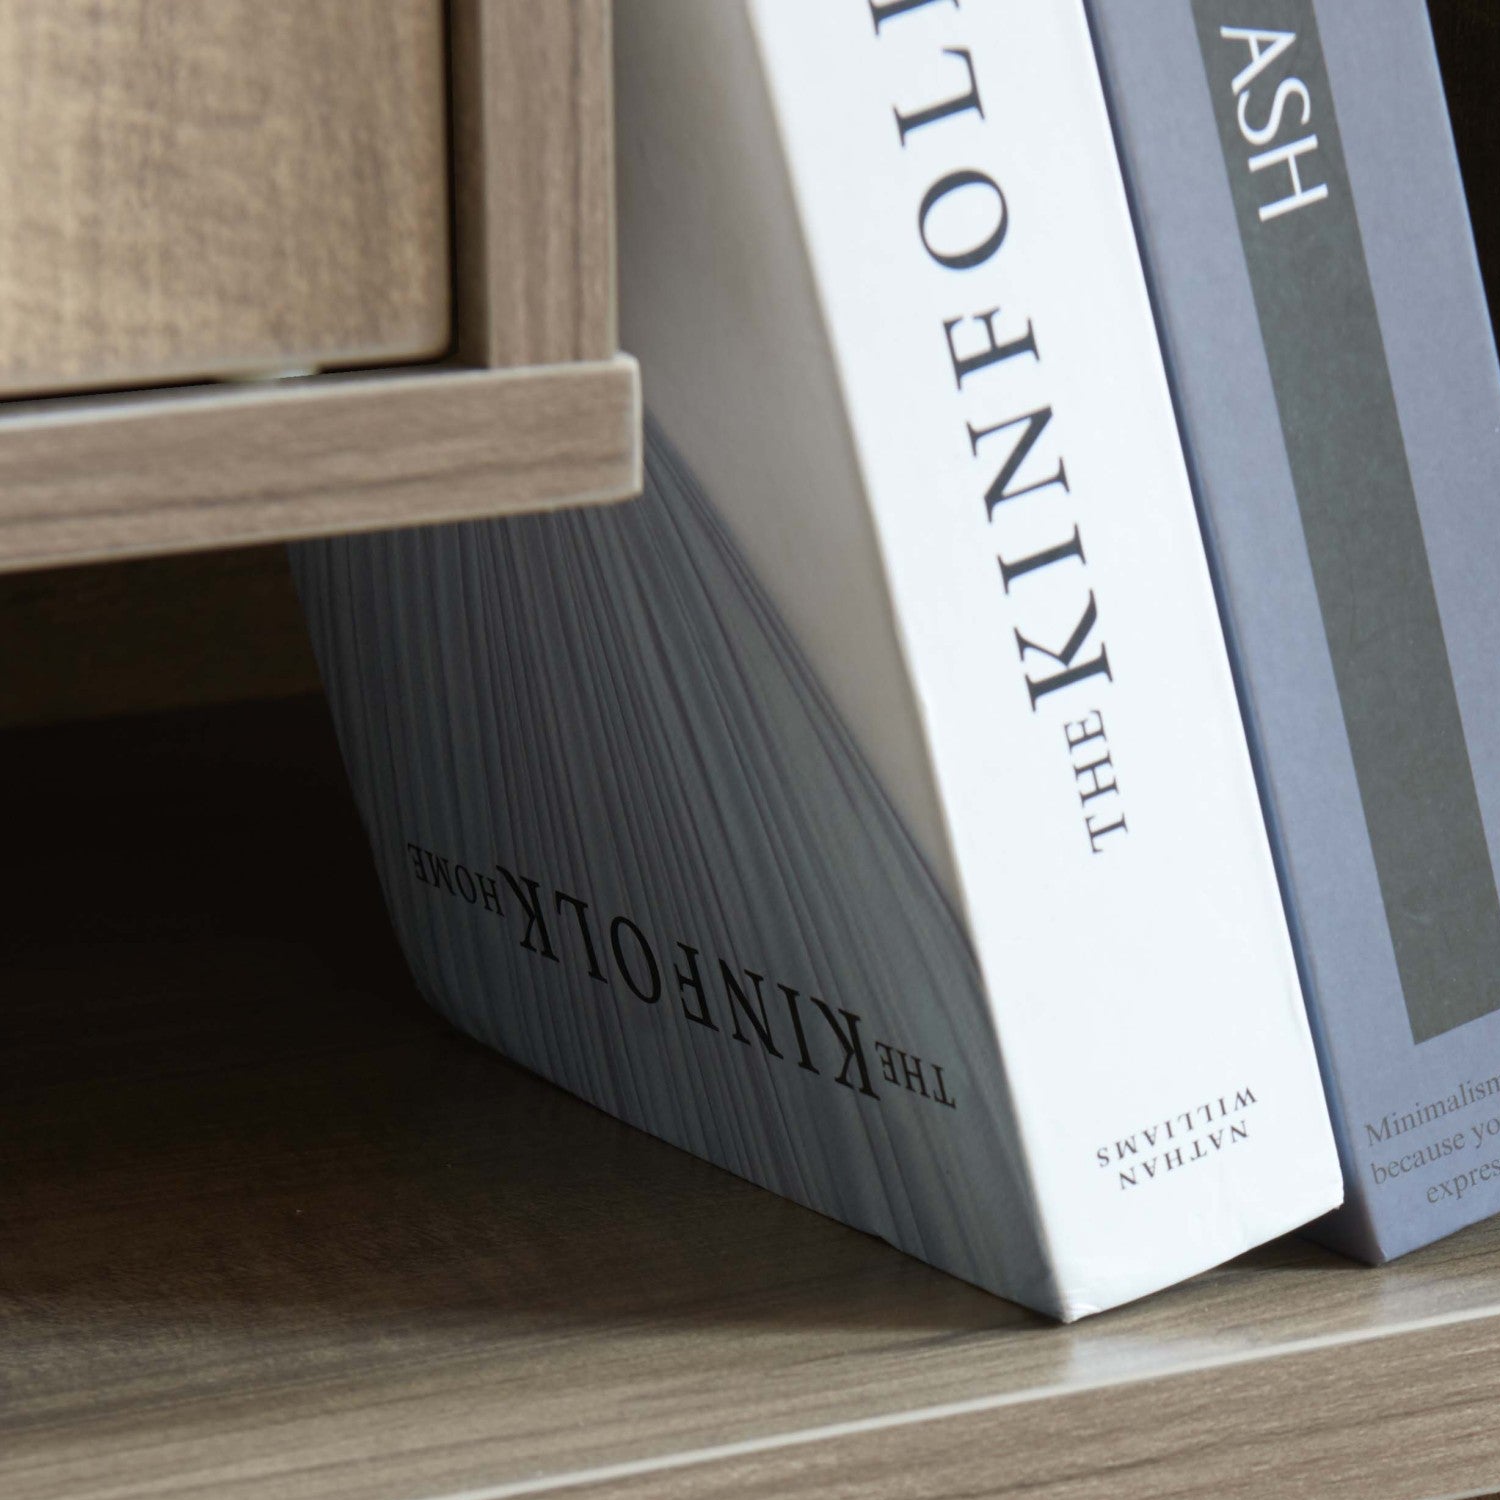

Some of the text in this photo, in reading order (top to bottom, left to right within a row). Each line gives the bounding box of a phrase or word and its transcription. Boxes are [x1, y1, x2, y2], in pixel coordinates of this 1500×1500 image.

[1219, 25, 1329, 223] ASH
[867, 0, 1129, 853] THE KINFOL
[407, 843, 957, 1109] THE KINFOLK HOME
[1096, 1086, 1258, 1168] WILLIAMS
[1118, 1120, 1250, 1191] NATHAN
[1369, 1132, 1466, 1186] because
